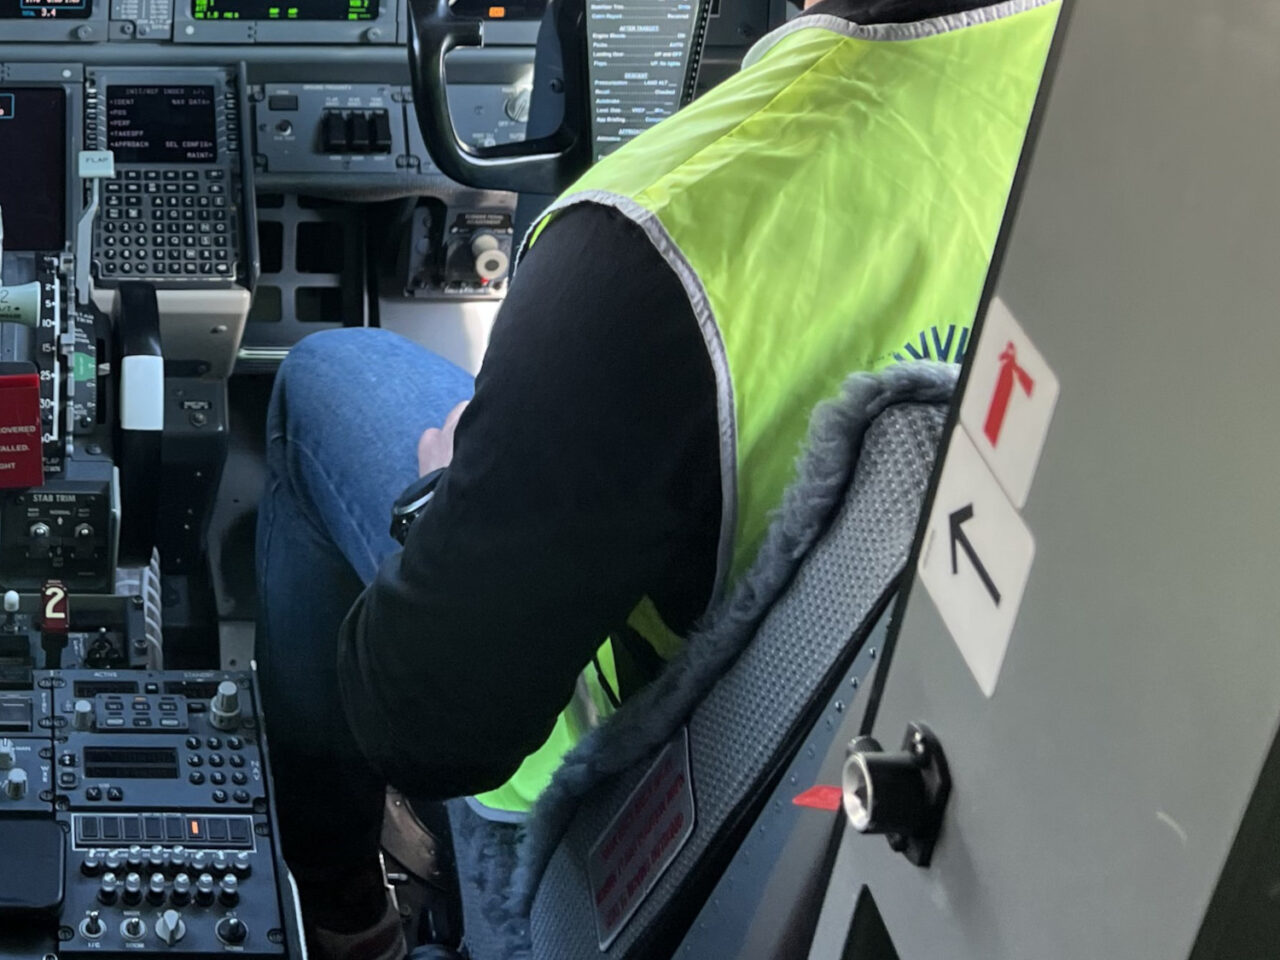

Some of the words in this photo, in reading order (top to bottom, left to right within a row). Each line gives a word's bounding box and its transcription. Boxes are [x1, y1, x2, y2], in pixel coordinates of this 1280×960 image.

[41, 9, 56, 17] 3.4
[0, 290, 9, 303] 2
[42, 319, 52, 328] 10
[42, 344, 52, 352] 15
[40, 370, 52, 380] 25
[40, 398, 52, 409] 30
[33, 494, 54, 503] STAB
[56, 494, 76, 503] TRIM
[45, 587, 65, 618] 2
